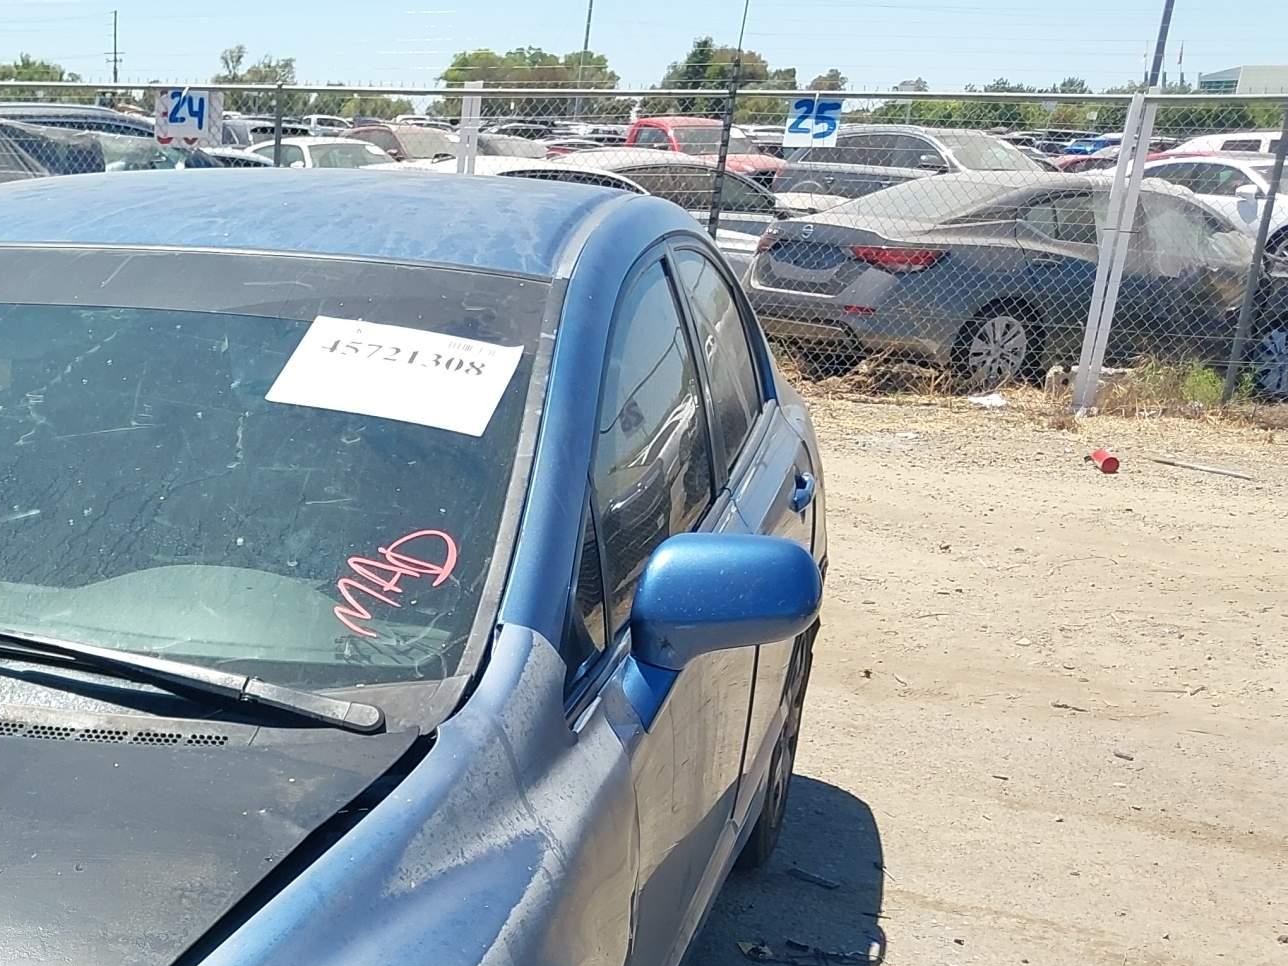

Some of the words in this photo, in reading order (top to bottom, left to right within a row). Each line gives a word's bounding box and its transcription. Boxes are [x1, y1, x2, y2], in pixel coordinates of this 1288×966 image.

[168, 91, 205, 130] 24
[787, 99, 842, 139] 25
[321, 338, 486, 377] 45721308
